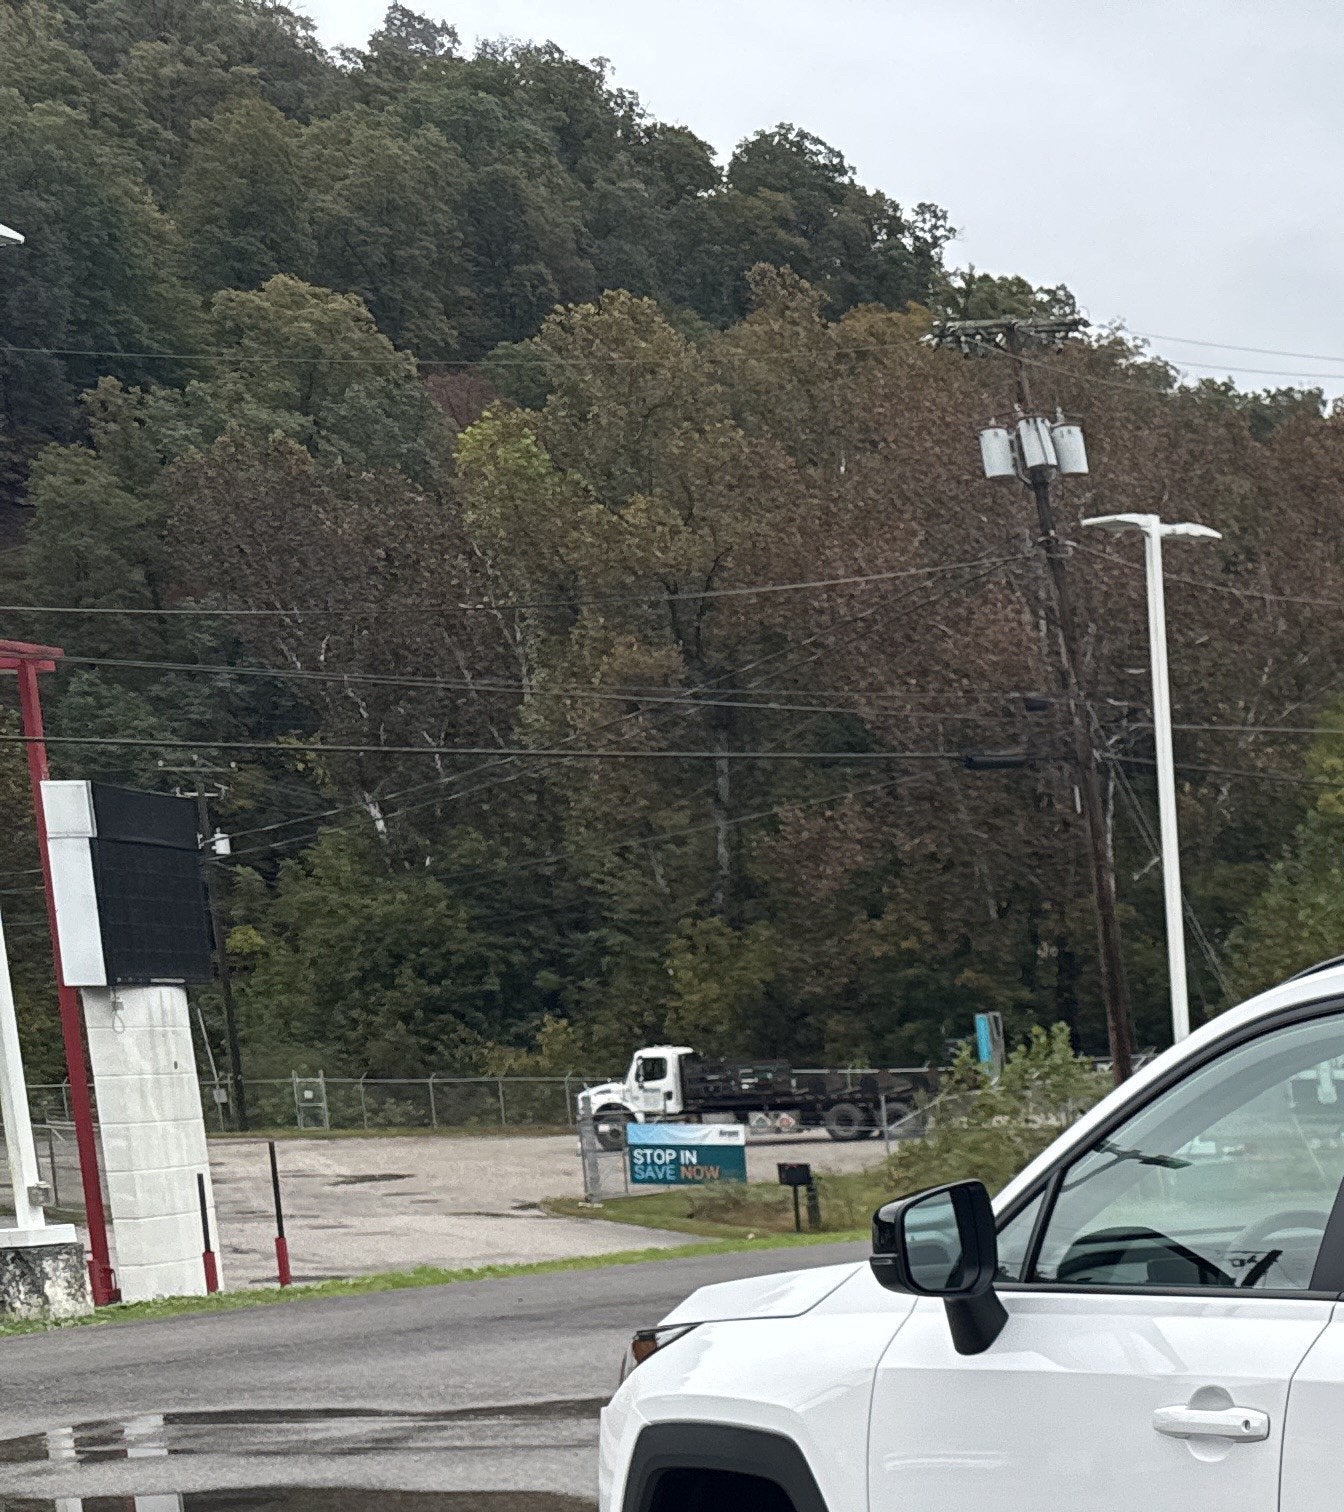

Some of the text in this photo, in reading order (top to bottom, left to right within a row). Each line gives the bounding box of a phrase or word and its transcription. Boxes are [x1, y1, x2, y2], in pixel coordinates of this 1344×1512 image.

[633, 1149, 698, 1165] STOP IN
[634, 1165, 720, 1181] SAVE NOW
